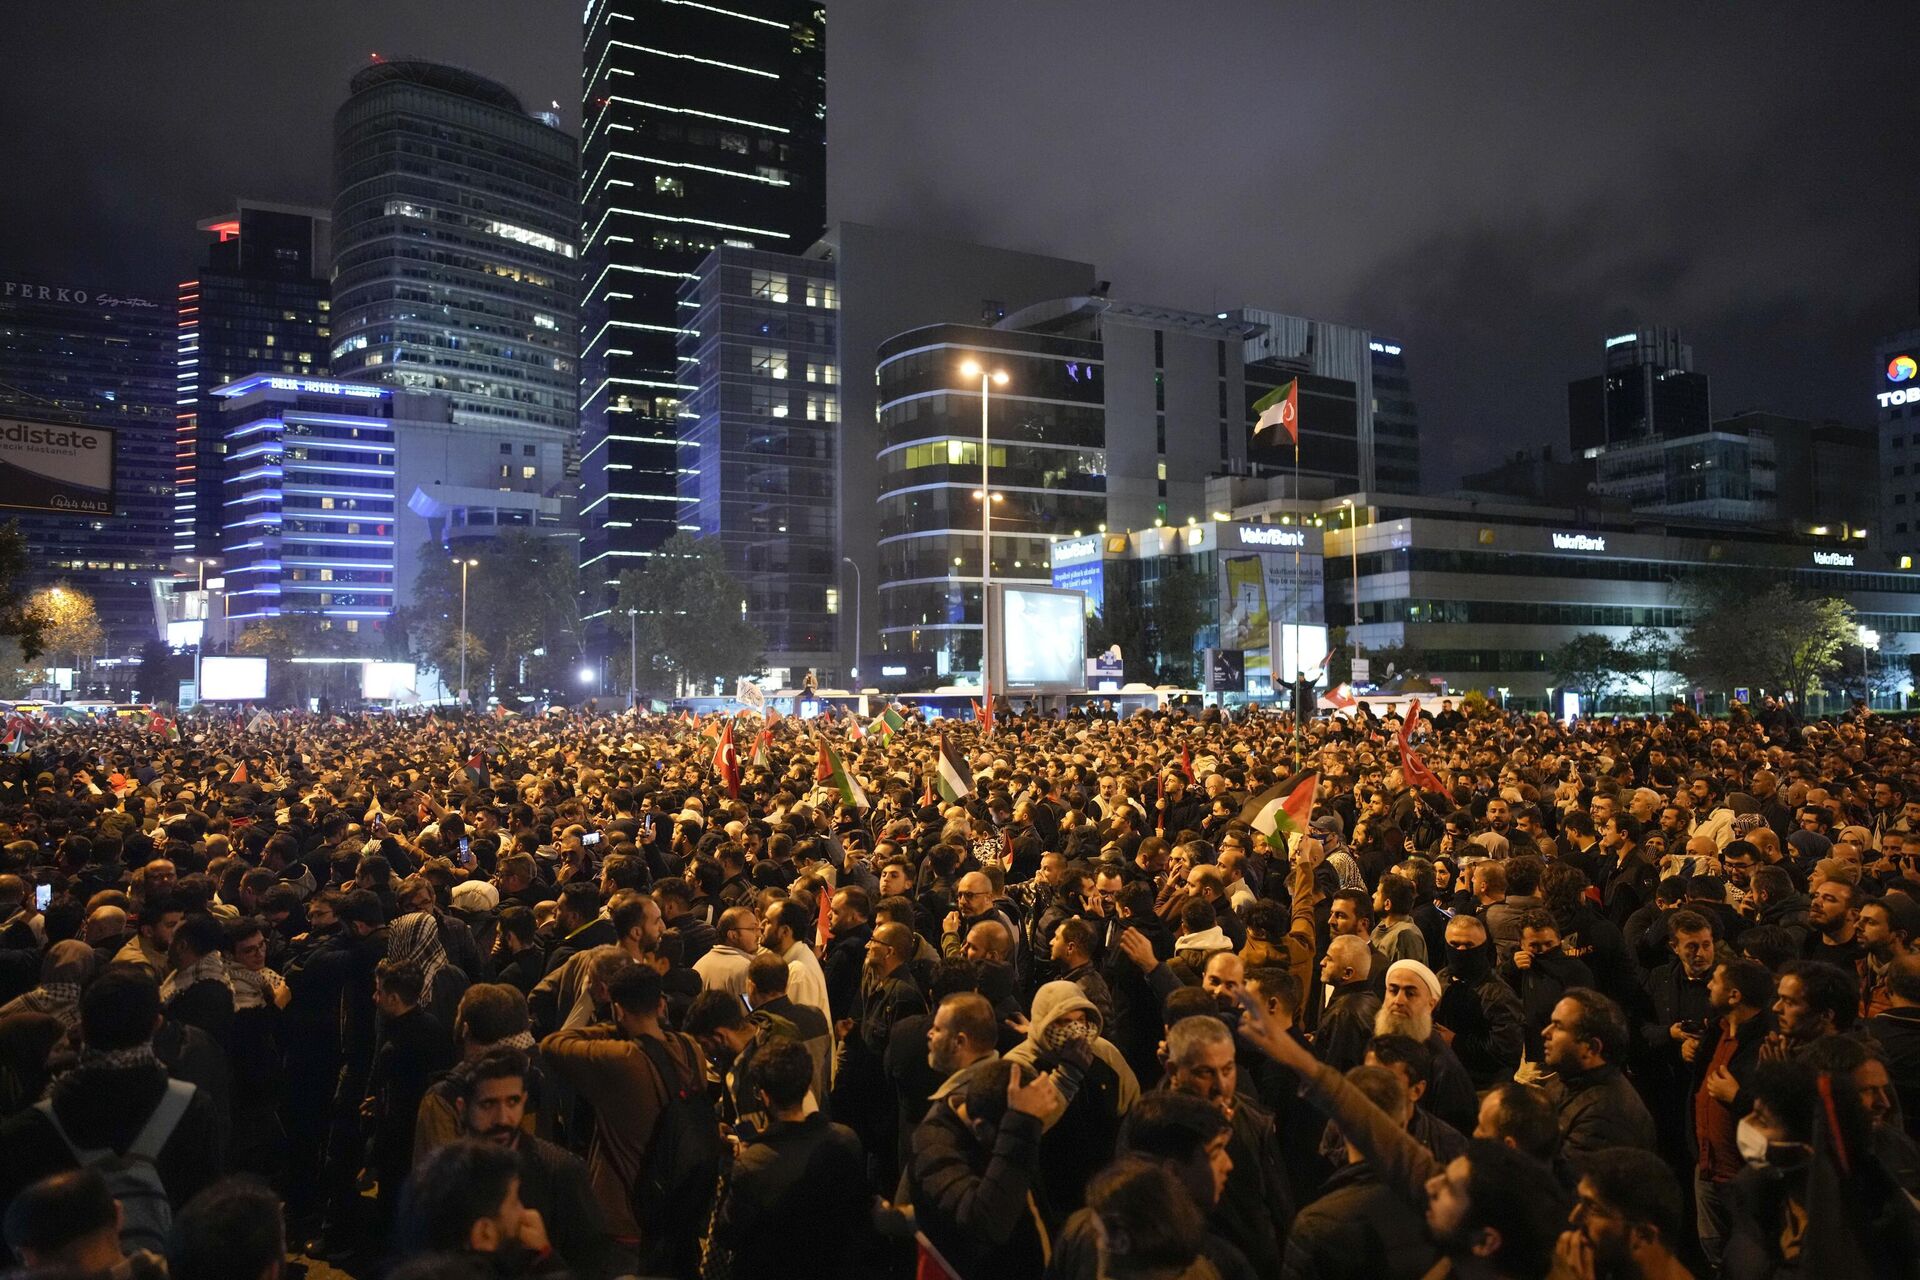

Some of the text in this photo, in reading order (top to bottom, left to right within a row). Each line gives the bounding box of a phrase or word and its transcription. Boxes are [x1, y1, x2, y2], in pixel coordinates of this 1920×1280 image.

[5, 281, 88, 304] FERKO
[271, 379, 299, 391] DELTA
[304, 382, 341, 395] HOTELS
[0, 424, 98, 450] distate
[56, 497, 79, 509] 444
[1239, 527, 1305, 546] VakıfBank
[1552, 532, 1605, 552] VakıfBank
[1813, 551, 1854, 567] VakıfBank
